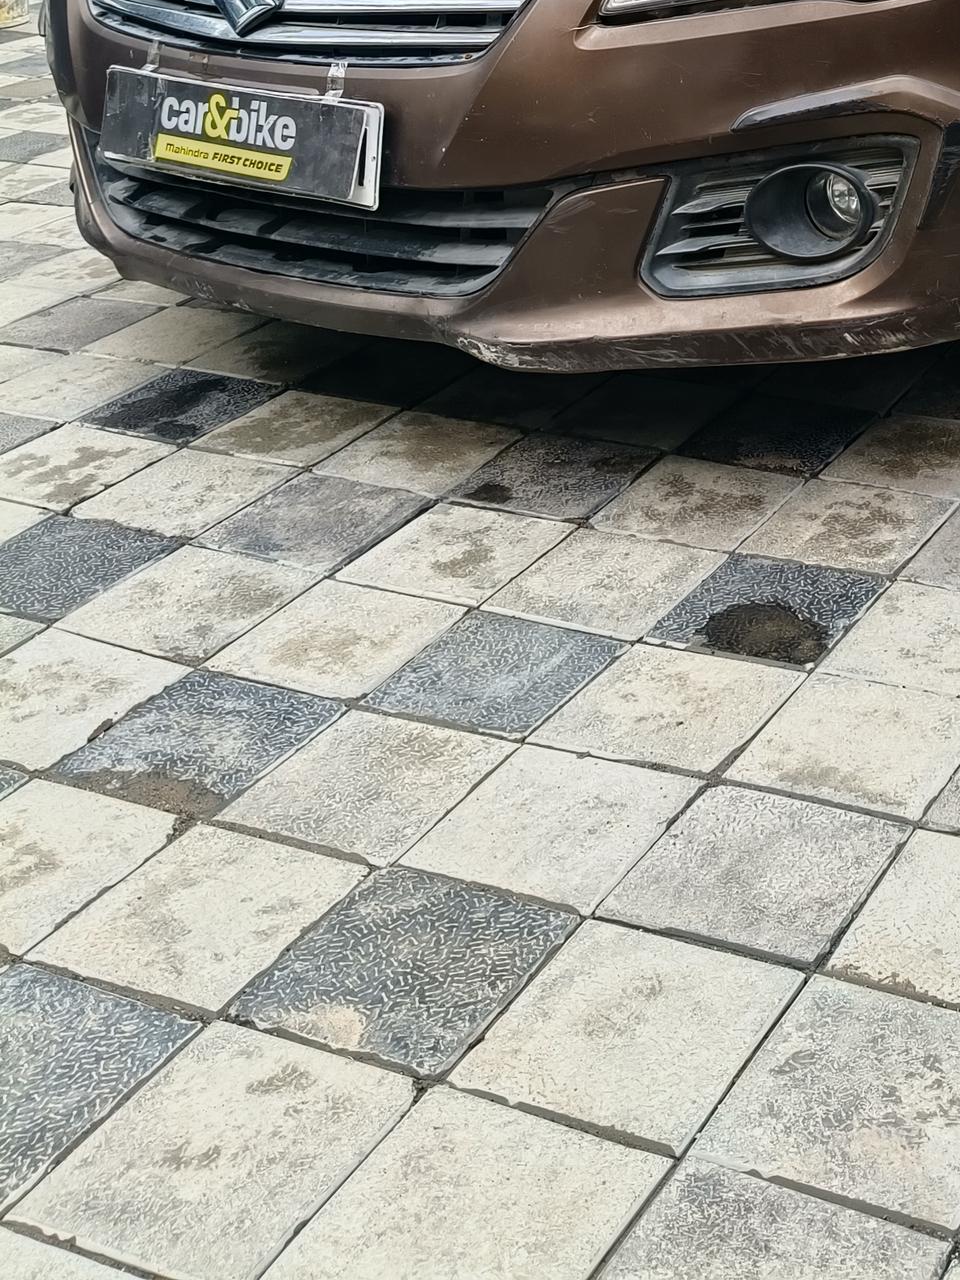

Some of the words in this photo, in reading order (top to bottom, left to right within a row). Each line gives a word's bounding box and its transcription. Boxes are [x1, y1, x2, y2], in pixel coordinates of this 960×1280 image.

[160, 93, 297, 151] car&bike
[165, 143, 209, 159] Mahindra
[211, 152, 242, 166] FIRST
[242, 157, 283, 173] CHOICE
